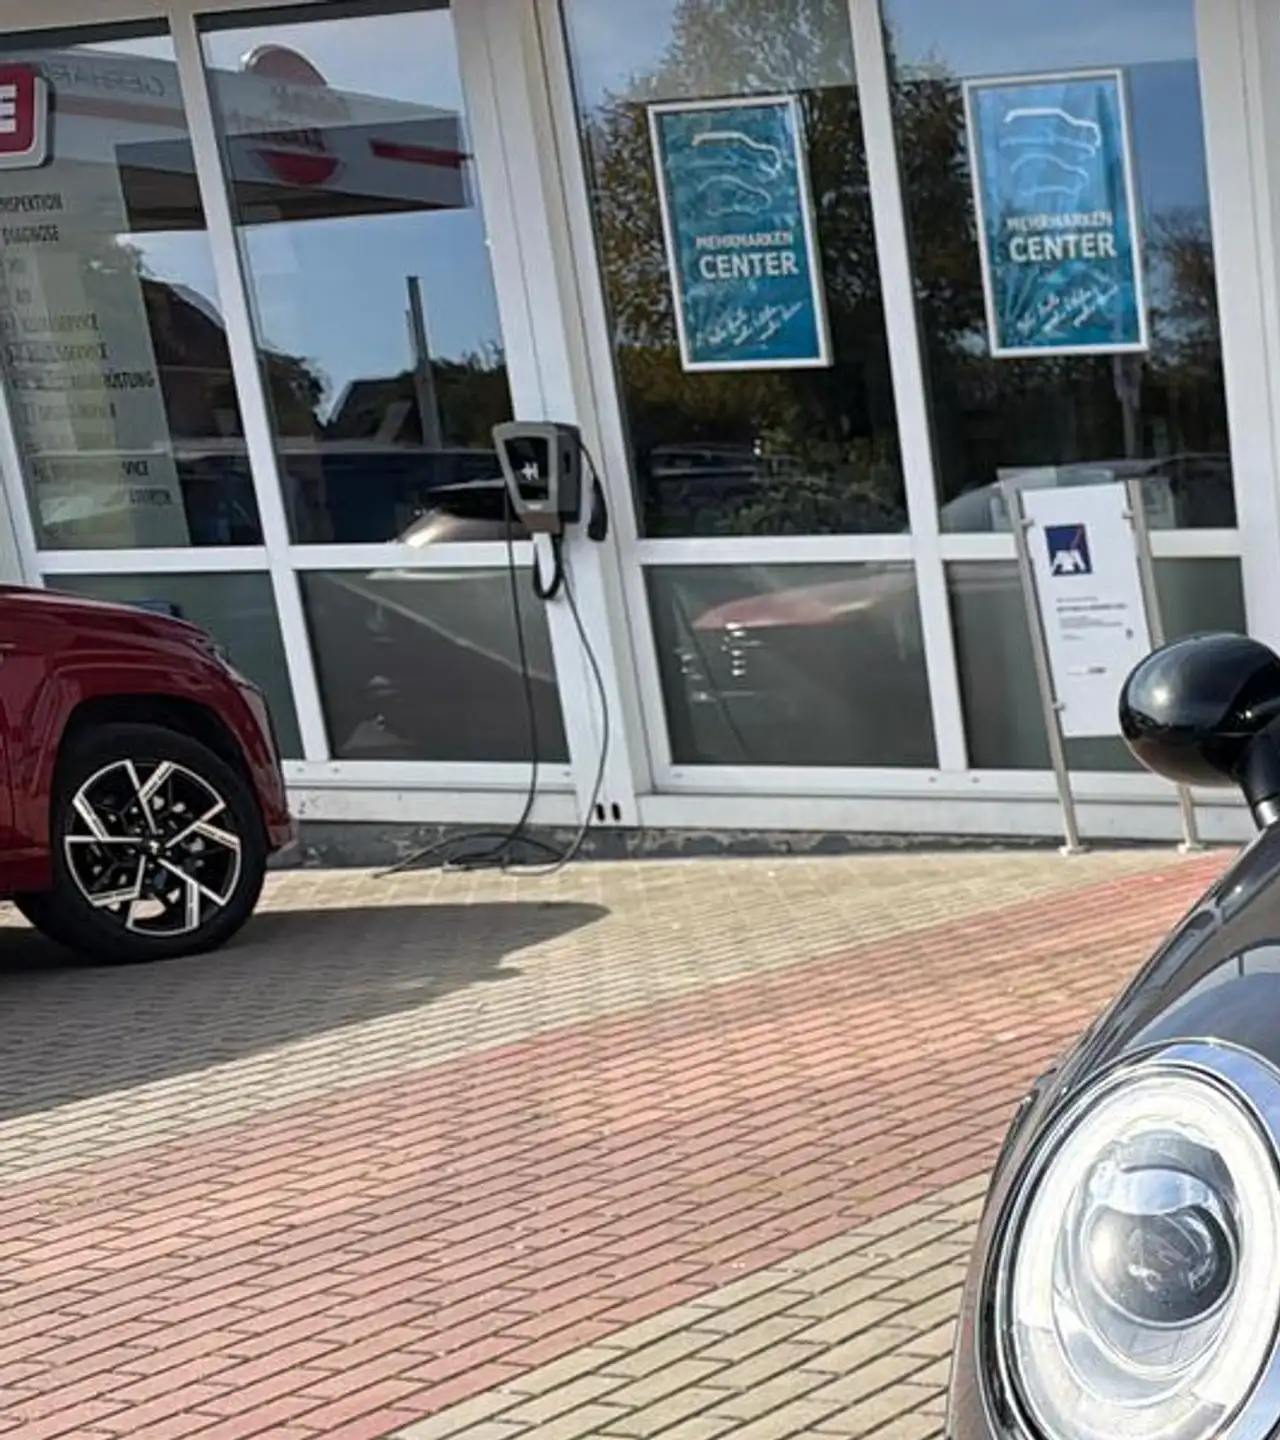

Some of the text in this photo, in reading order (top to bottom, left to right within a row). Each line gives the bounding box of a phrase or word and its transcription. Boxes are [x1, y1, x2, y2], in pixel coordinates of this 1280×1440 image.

[695, 230, 793, 249] MEHRMARKEN
[1009, 231, 1117, 263] CENTER
[699, 251, 799, 280] CENTER
